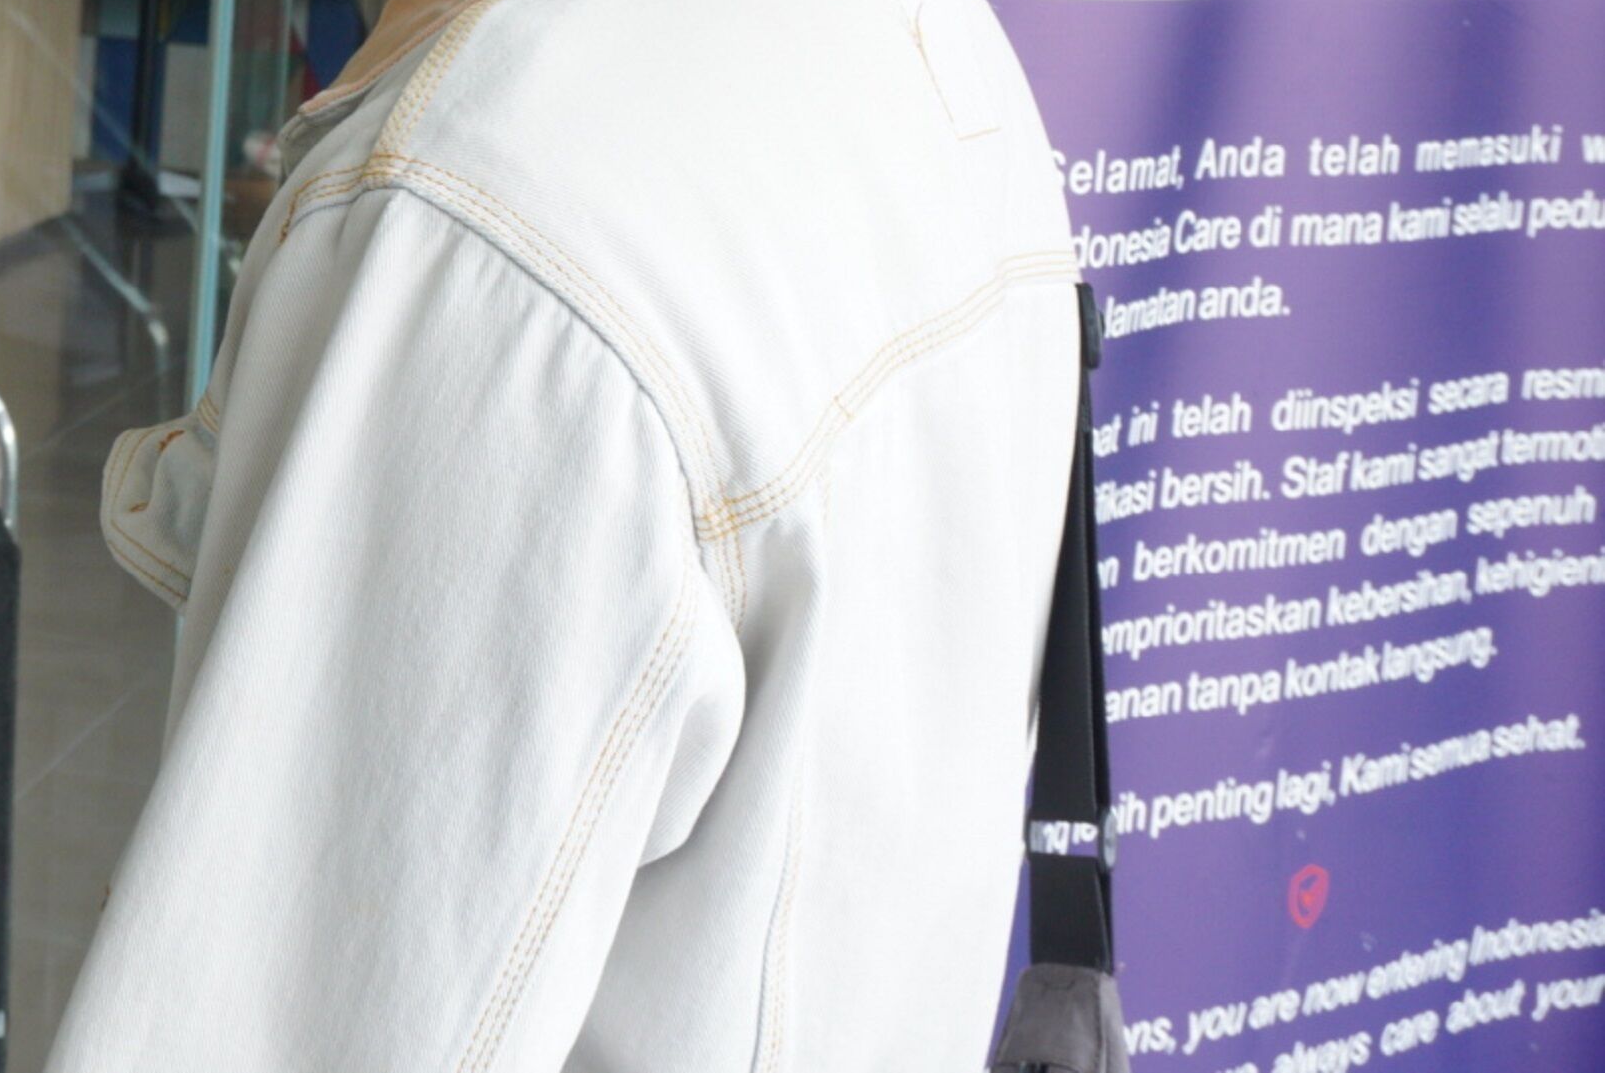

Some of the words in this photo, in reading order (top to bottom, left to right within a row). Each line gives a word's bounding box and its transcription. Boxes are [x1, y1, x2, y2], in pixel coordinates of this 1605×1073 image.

[1194, 136, 1287, 181] Anda
[1307, 133, 1401, 177] telah
[1414, 122, 1563, 173] memasuki
[1173, 208, 1242, 255] Care
[1248, 204, 1284, 248] di
[1290, 210, 1384, 247] mana
[1387, 200, 1453, 243] kami
[1451, 189, 1525, 237] selalu
[1197, 274, 1292, 321] anda.
[1127, 400, 1160, 448] ini
[1171, 391, 1253, 439] telah
[1270, 376, 1421, 436] diinspeksi
[1427, 370, 1509, 416] secara
[1521, 366, 1605, 402] resm
[1159, 465, 1271, 511] bersih.
[1279, 449, 1351, 500] Staf
[1349, 441, 1418, 492] kami
[1416, 429, 1501, 483] sangat
[1501, 423, 1605, 466] termot
[1132, 526, 1347, 583] berkomitmen
[1359, 512, 1459, 559] dengan
[1465, 484, 1598, 541] sepenuh
[1325, 569, 1474, 627] kebersihan,
[1186, 670, 1283, 717] tanpa
[1283, 644, 1381, 700] kontak
[1380, 625, 1500, 684] langsung.
[1148, 776, 1276, 840] penting
[1275, 759, 1338, 816] lagi,
[1338, 741, 1412, 798] Kami
[1407, 729, 1492, 781] semua
[1490, 712, 1589, 759] sehat.
[1181, 1000, 1248, 1056] you
[1247, 988, 1302, 1031] are
[1301, 970, 1367, 1017] now
[1365, 937, 1470, 1001] entering
[1379, 1009, 1441, 1058] care
[1444, 978, 1527, 1036] about
